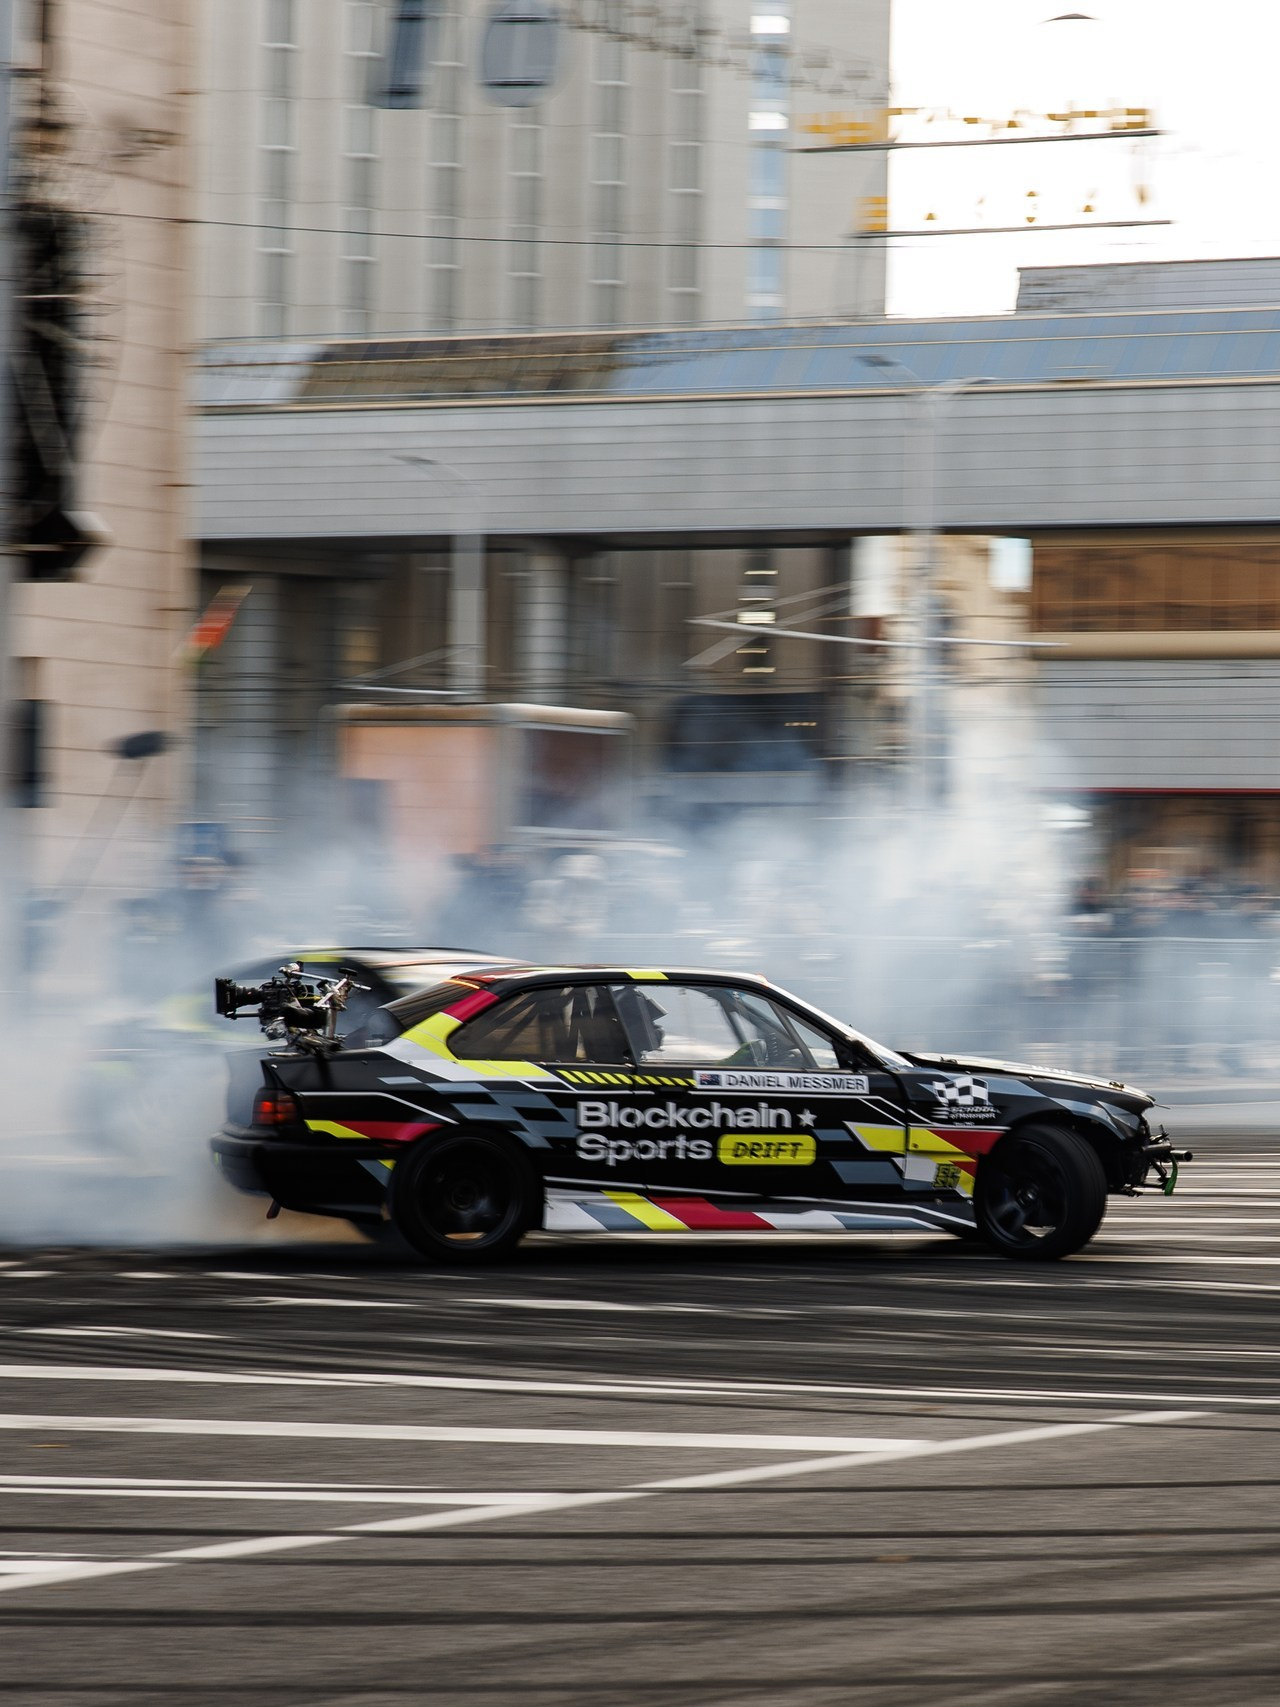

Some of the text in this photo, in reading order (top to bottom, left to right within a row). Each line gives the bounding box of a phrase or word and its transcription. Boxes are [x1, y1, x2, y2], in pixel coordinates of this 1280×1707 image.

[727, 1074, 865, 1091] DANIEL MESSMER
[576, 1101, 792, 1128] Blockchain
[576, 1133, 803, 1166] Sports DRIFT
